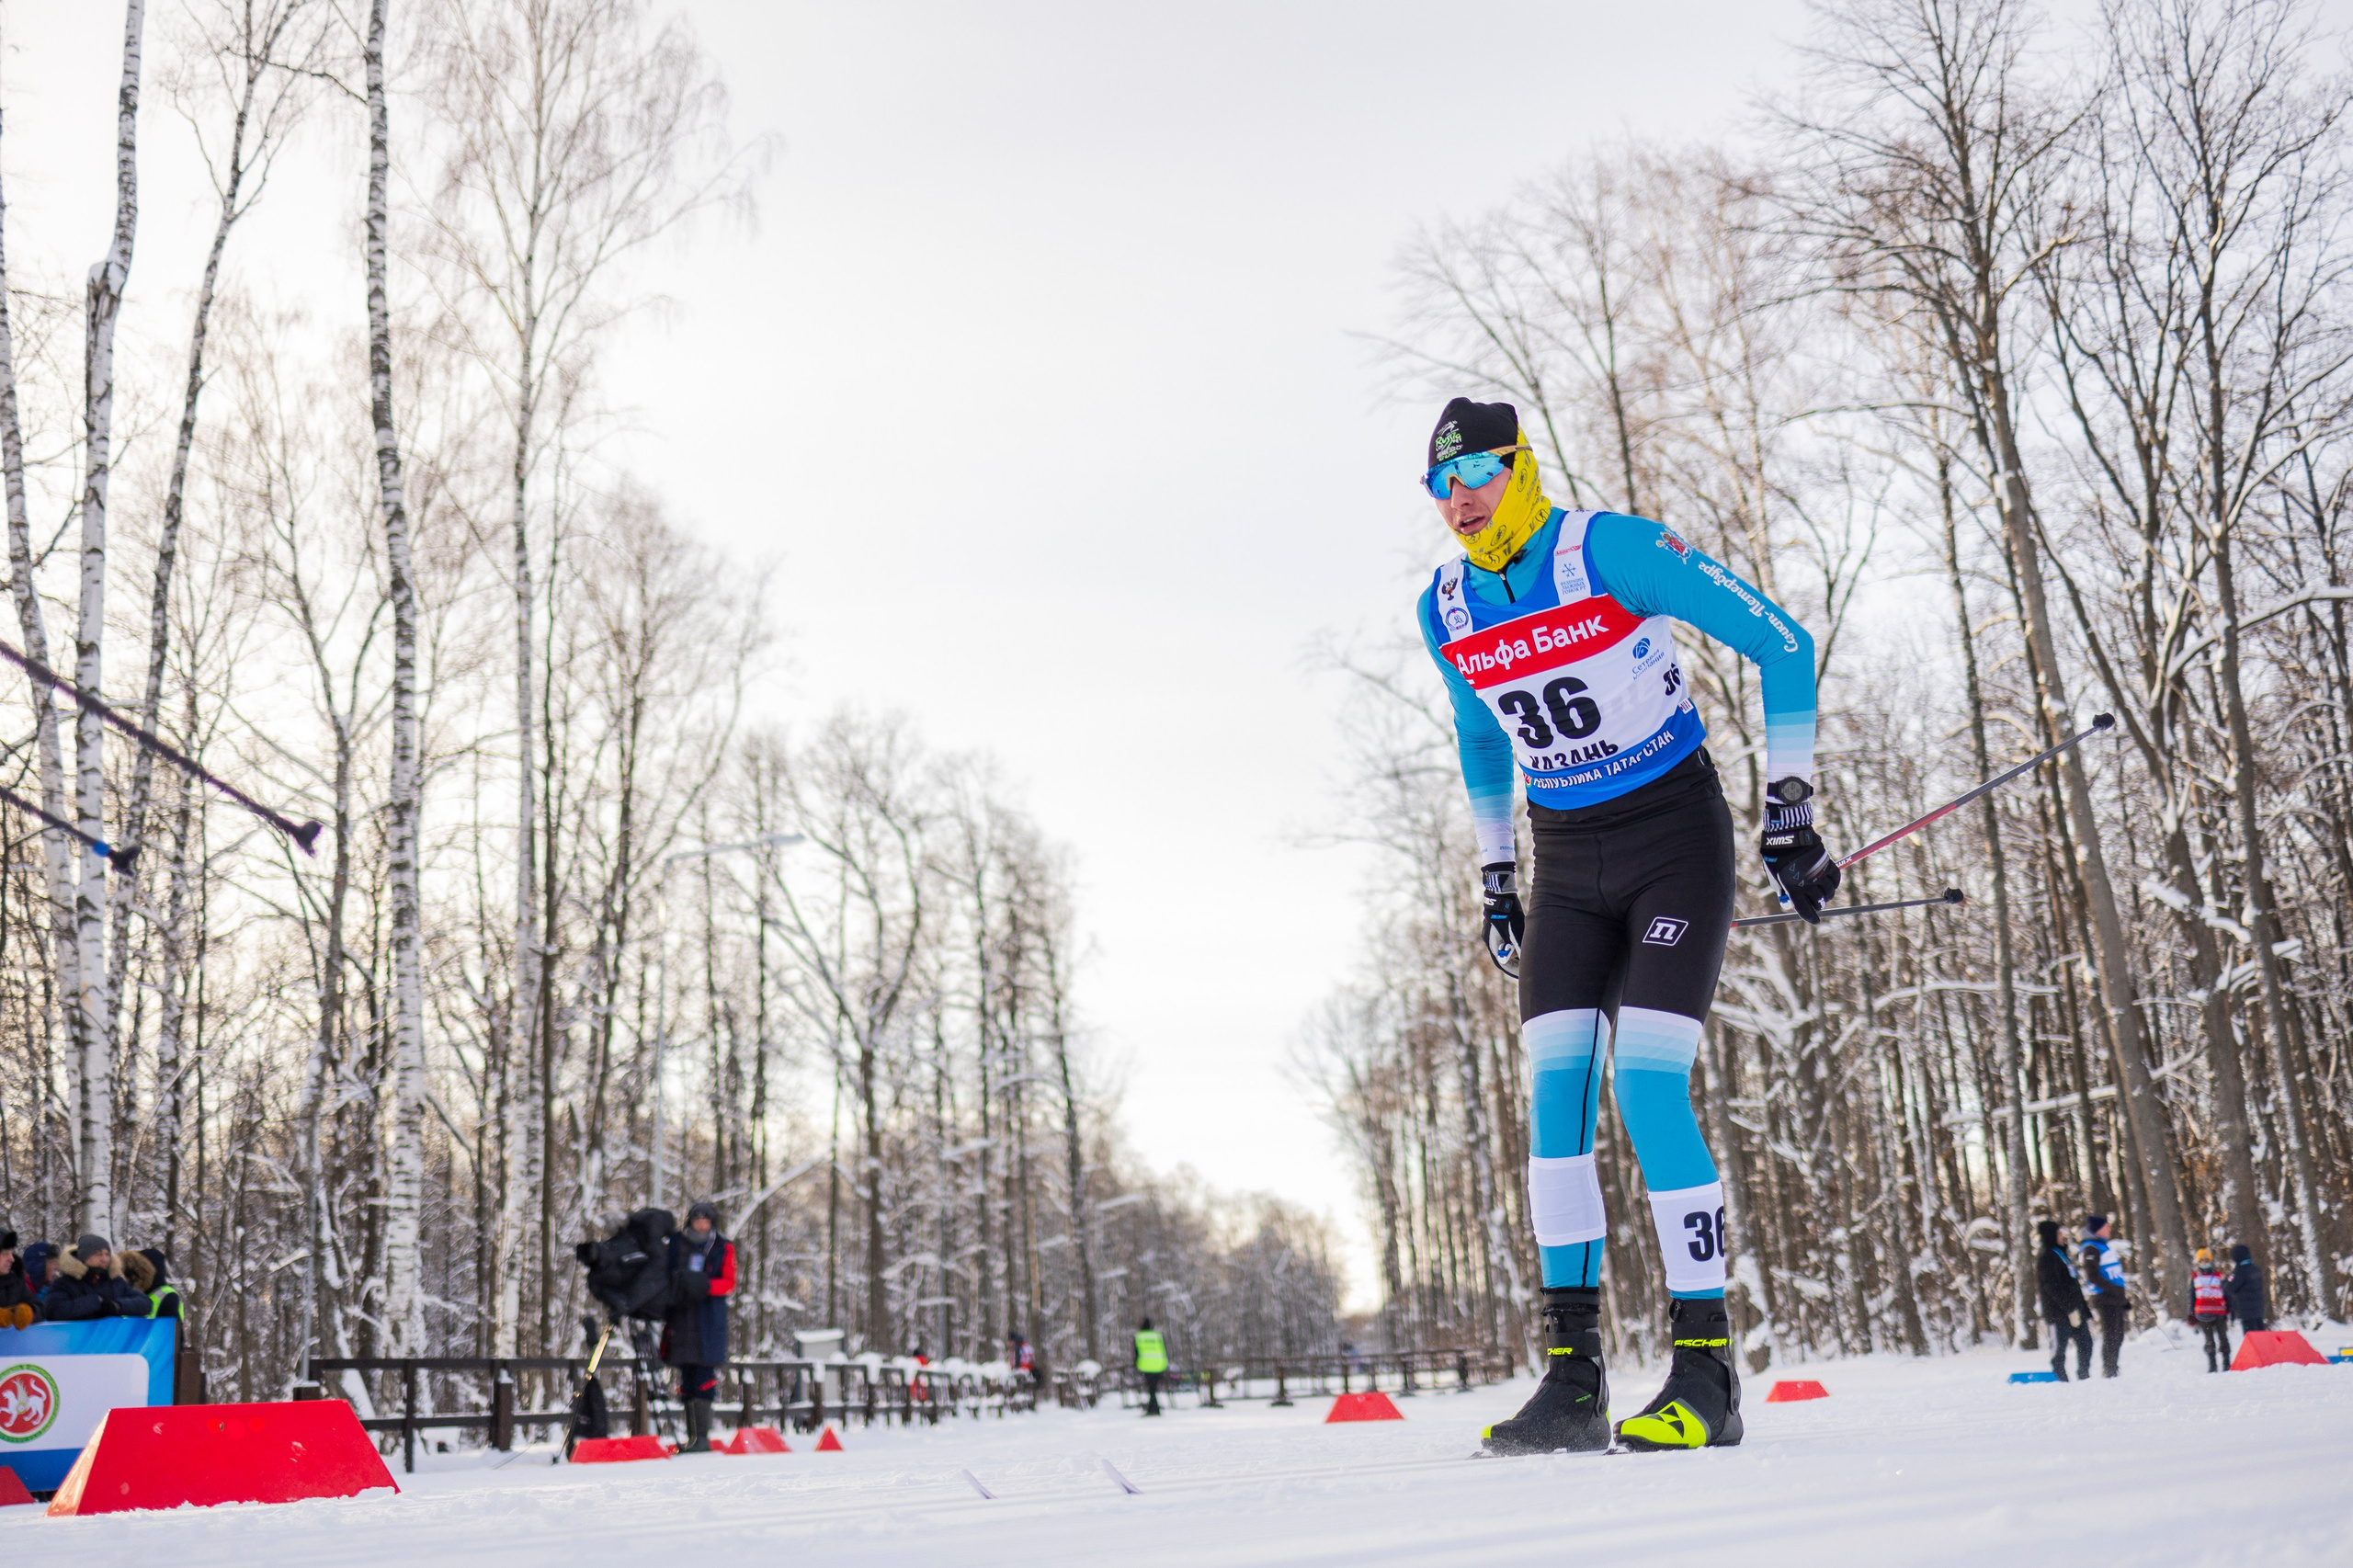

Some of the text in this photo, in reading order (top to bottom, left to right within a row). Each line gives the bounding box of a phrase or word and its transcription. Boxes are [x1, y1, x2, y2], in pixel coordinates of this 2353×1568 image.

[1456, 614, 1609, 676] Альфа Банк
[1498, 676, 1601, 749] 36
[1674, 1338, 1728, 1347] FISCHER
